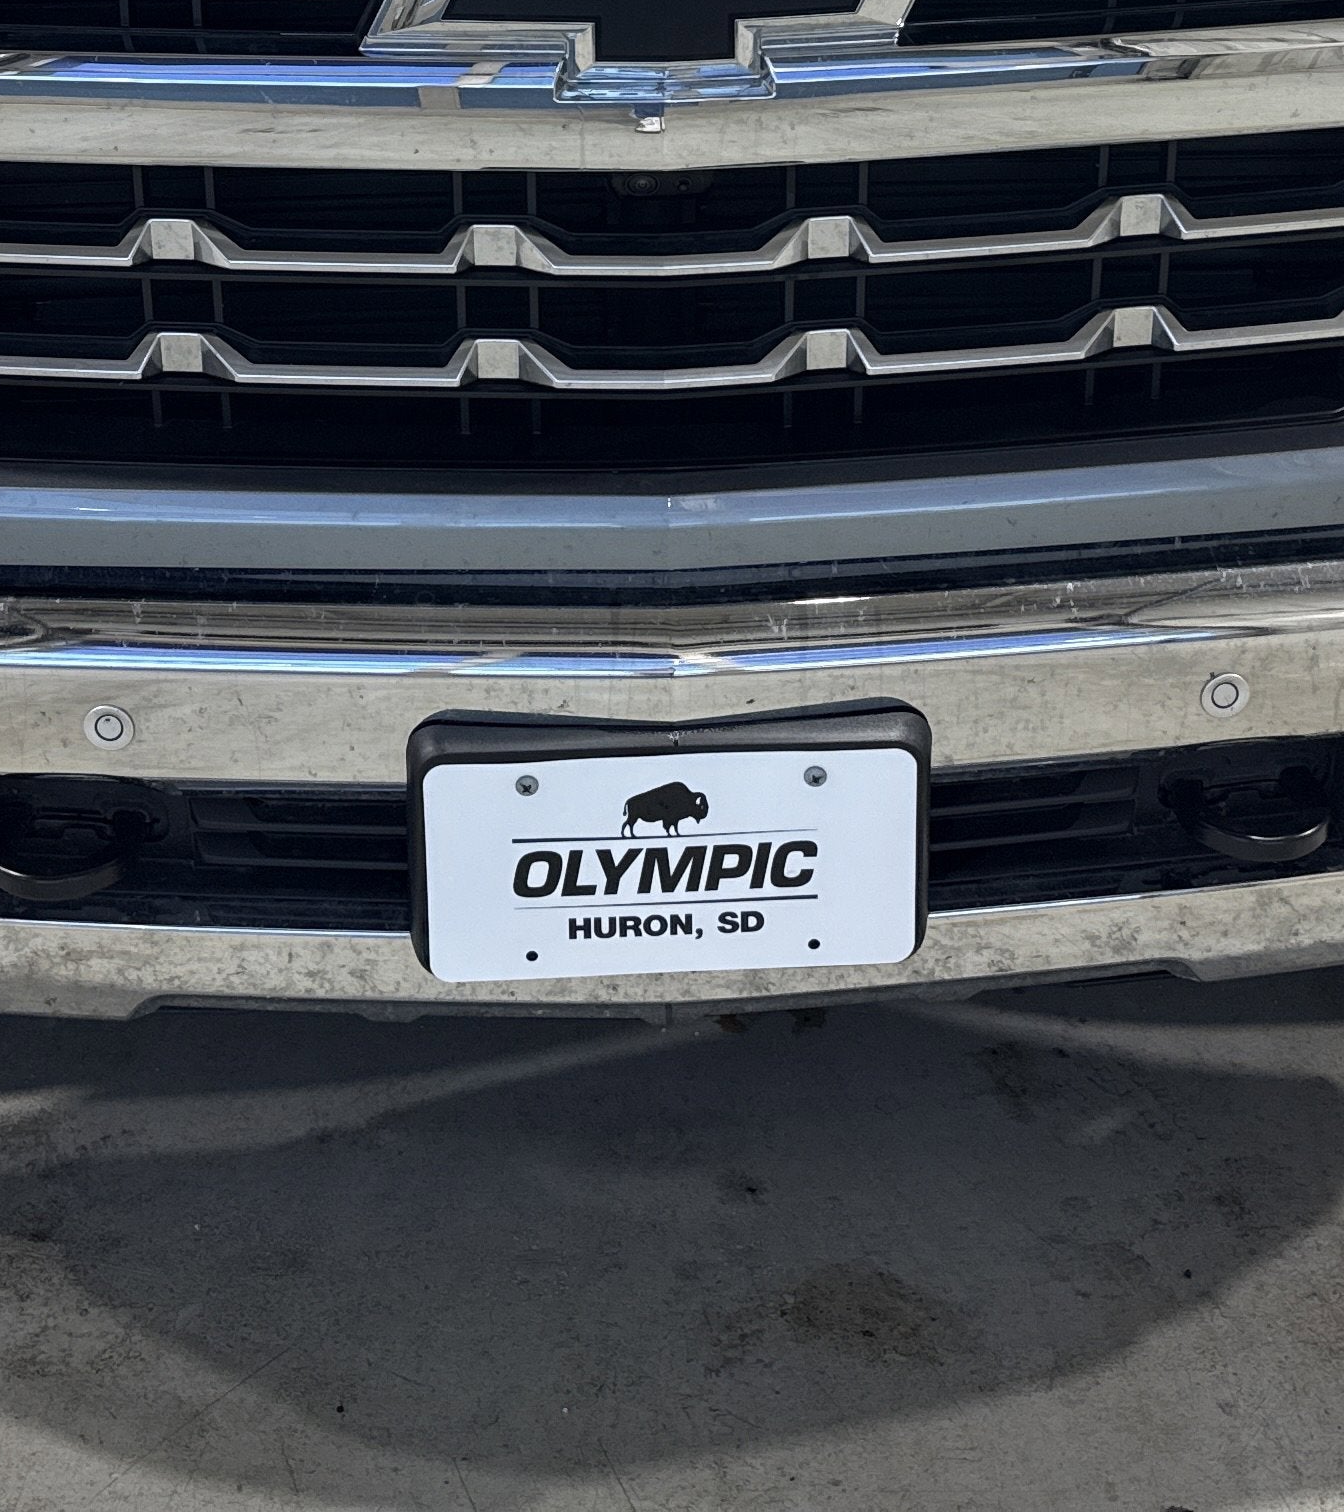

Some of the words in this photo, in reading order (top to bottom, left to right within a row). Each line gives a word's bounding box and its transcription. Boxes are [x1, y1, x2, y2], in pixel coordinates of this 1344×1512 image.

[512, 840, 819, 899] OLYMPIC
[567, 913, 704, 941] HURON,
[717, 910, 765, 934] SD
